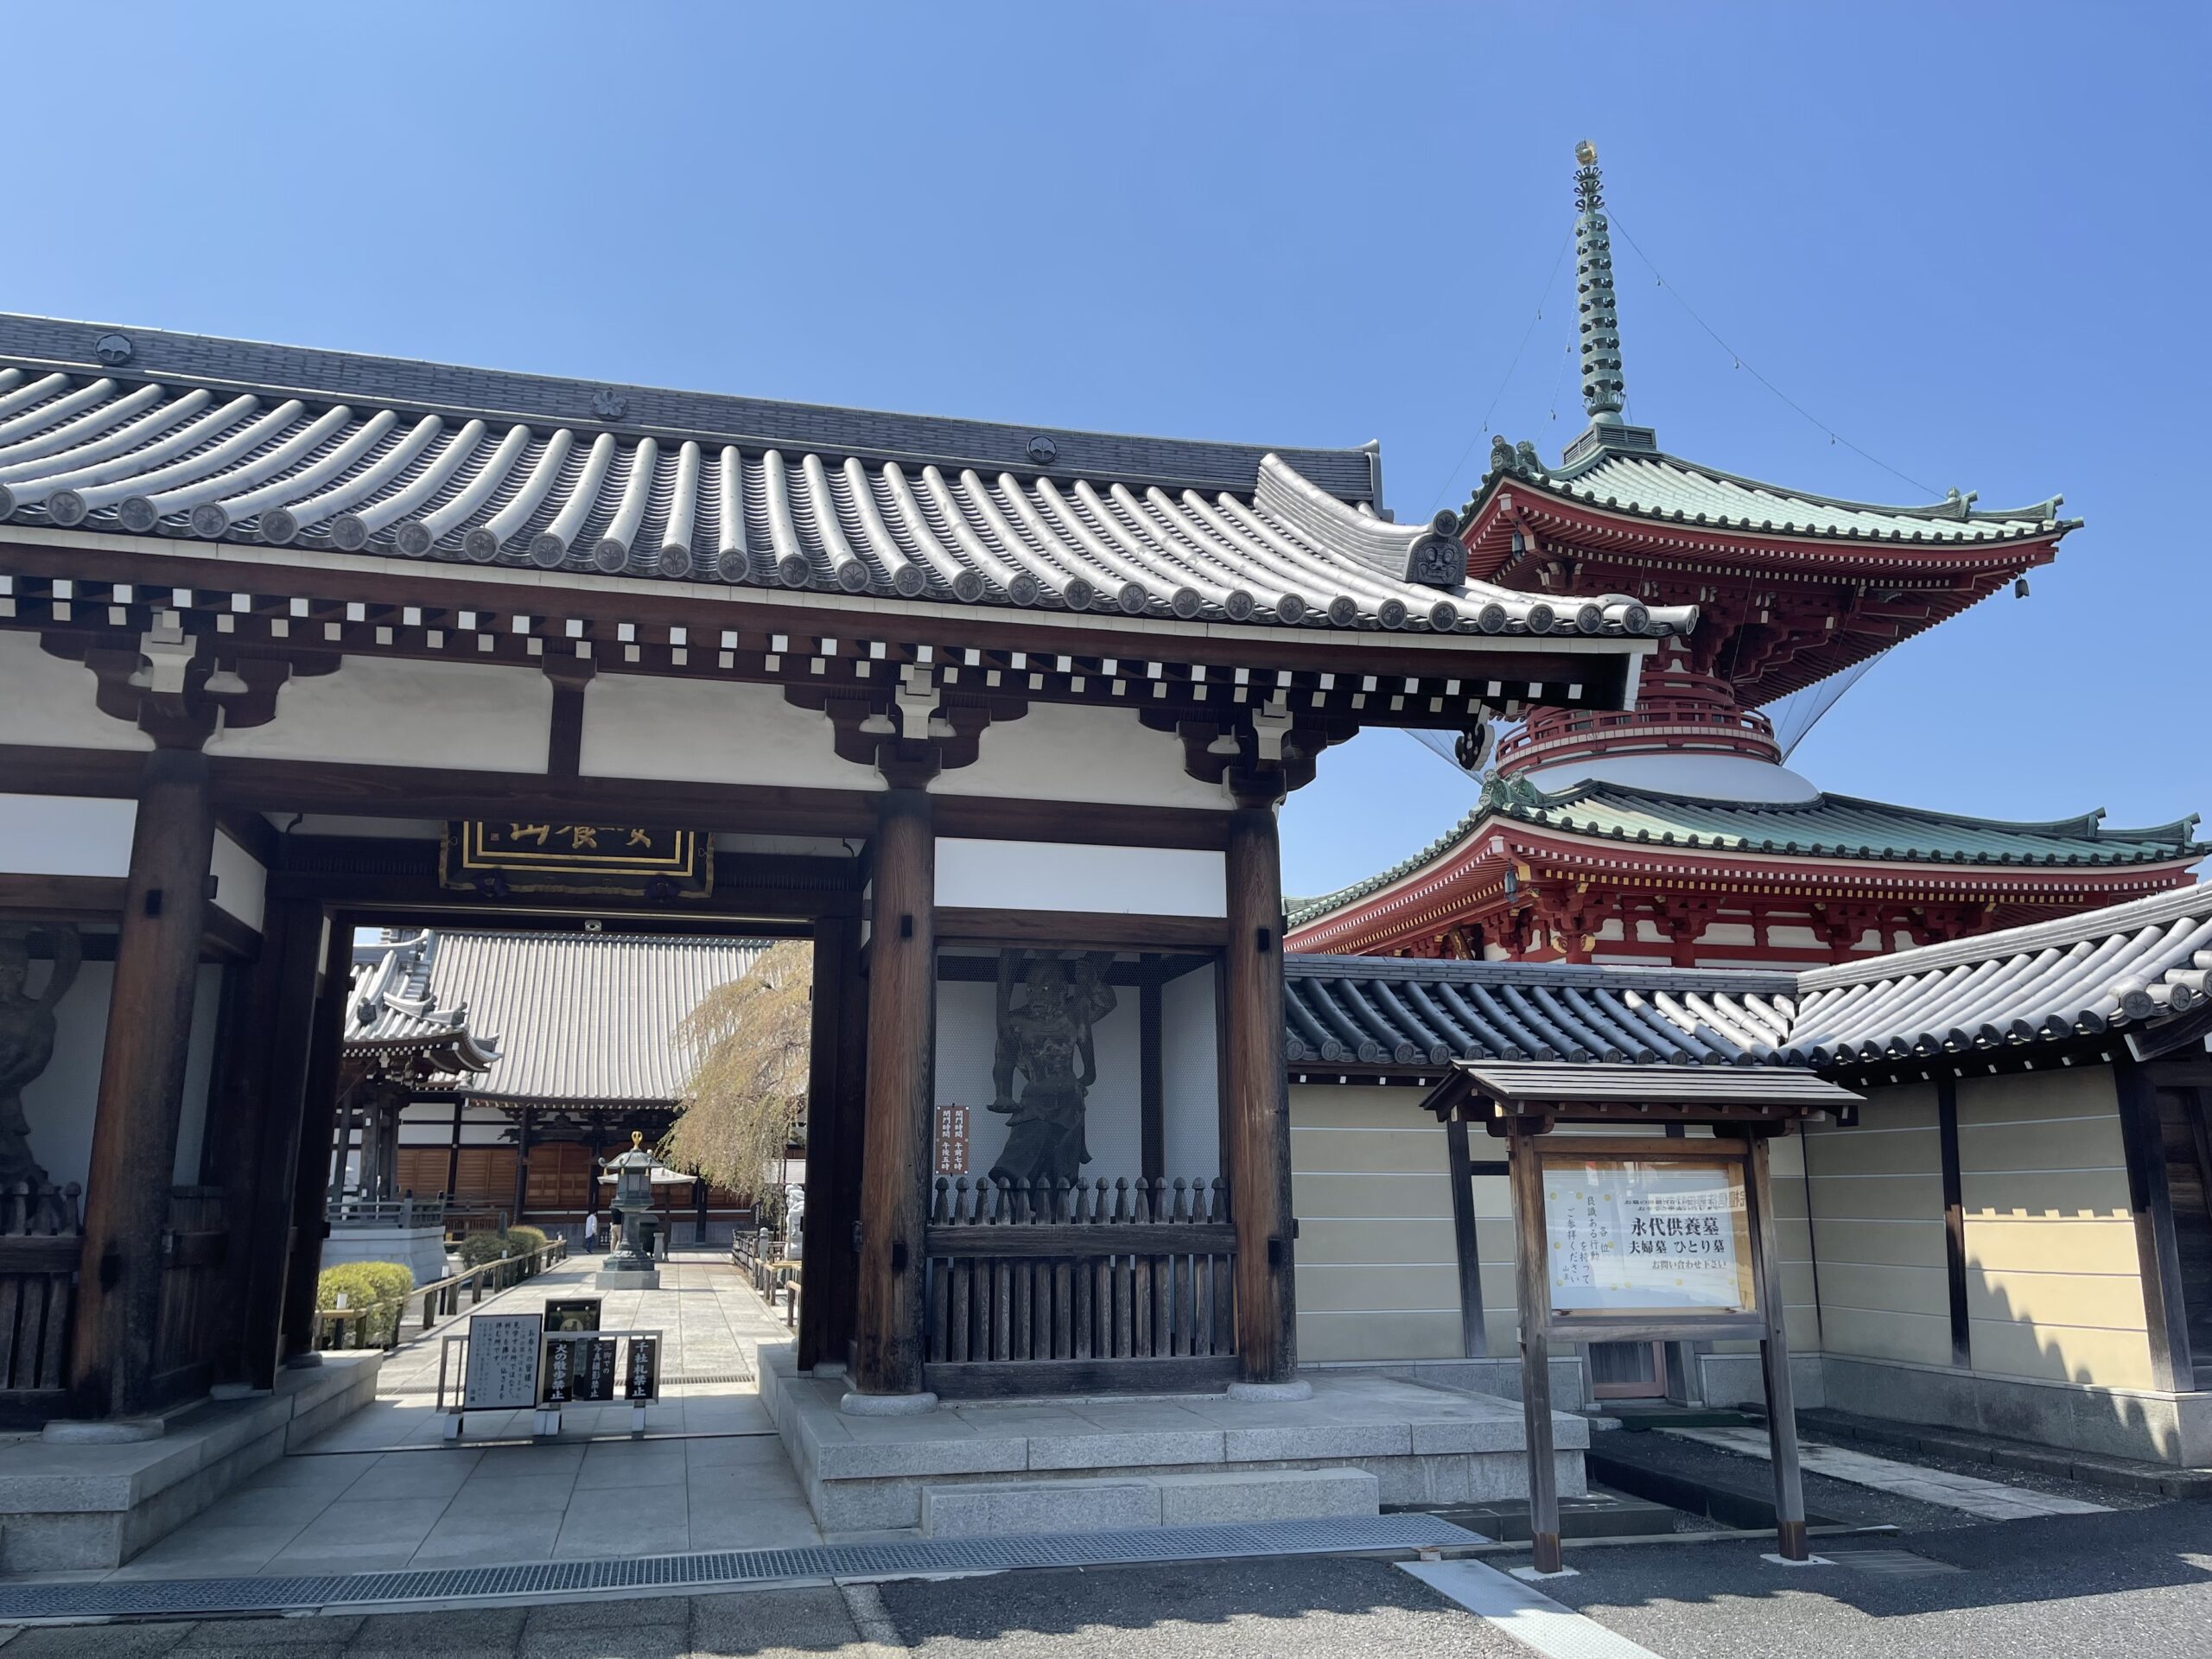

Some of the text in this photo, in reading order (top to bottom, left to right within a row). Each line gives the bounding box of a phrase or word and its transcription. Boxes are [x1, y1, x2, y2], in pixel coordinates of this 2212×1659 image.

[941, 1141, 950, 1171] 午後五時
[954, 1141, 963, 1171] 午前七時
[1587, 1196, 1599, 1262] 良識ある行動
[1630, 1217, 1719, 1236] 永代供養墓
[1567, 1207, 1580, 1283] ご参拝ください
[1630, 1239, 1725, 1254] 夫婦墓 ひとり墓
[1562, 1265, 1570, 1281] 山主
[1580, 1241, 1590, 1284] を持って
[1652, 1259, 1726, 1270] お問い合わせ下さい
[550, 1344, 567, 1399] 犬の散歩禁止
[590, 1344, 601, 1397] 写真撮影禁止
[602, 1343, 612, 1374] 三脚での
[632, 1342, 650, 1397] 千社札禁止
